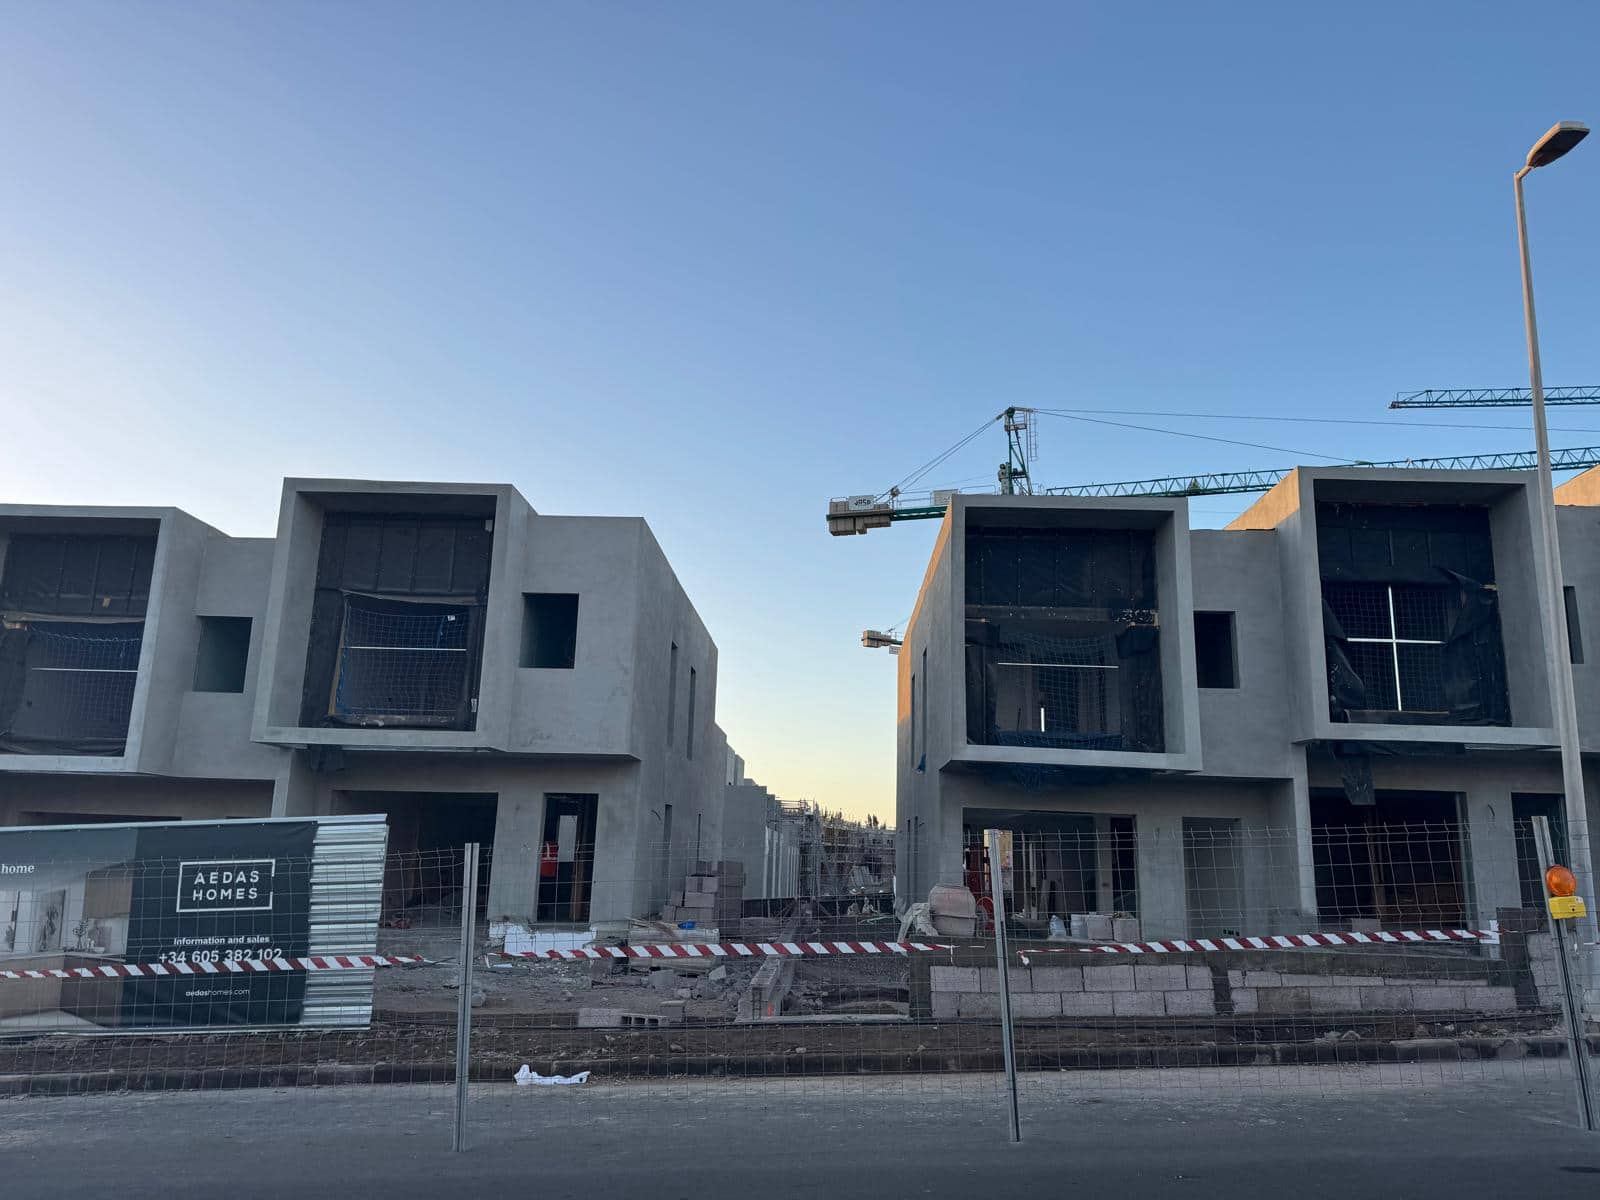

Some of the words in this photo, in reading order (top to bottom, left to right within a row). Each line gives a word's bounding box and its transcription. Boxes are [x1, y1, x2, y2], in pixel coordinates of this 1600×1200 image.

[1, 863, 35, 874] home
[194, 870, 260, 885] AEDAS
[192, 887, 258, 901] HOMES
[173, 936, 225, 945] Information
[227, 935, 244, 944] and
[247, 934, 270, 943] sales
[158, 951, 186, 964] +34
[191, 950, 219, 963] 605
[224, 949, 252, 961] 382
[257, 948, 282, 960] 102
[185, 988, 250, 997] aedashomes.com
